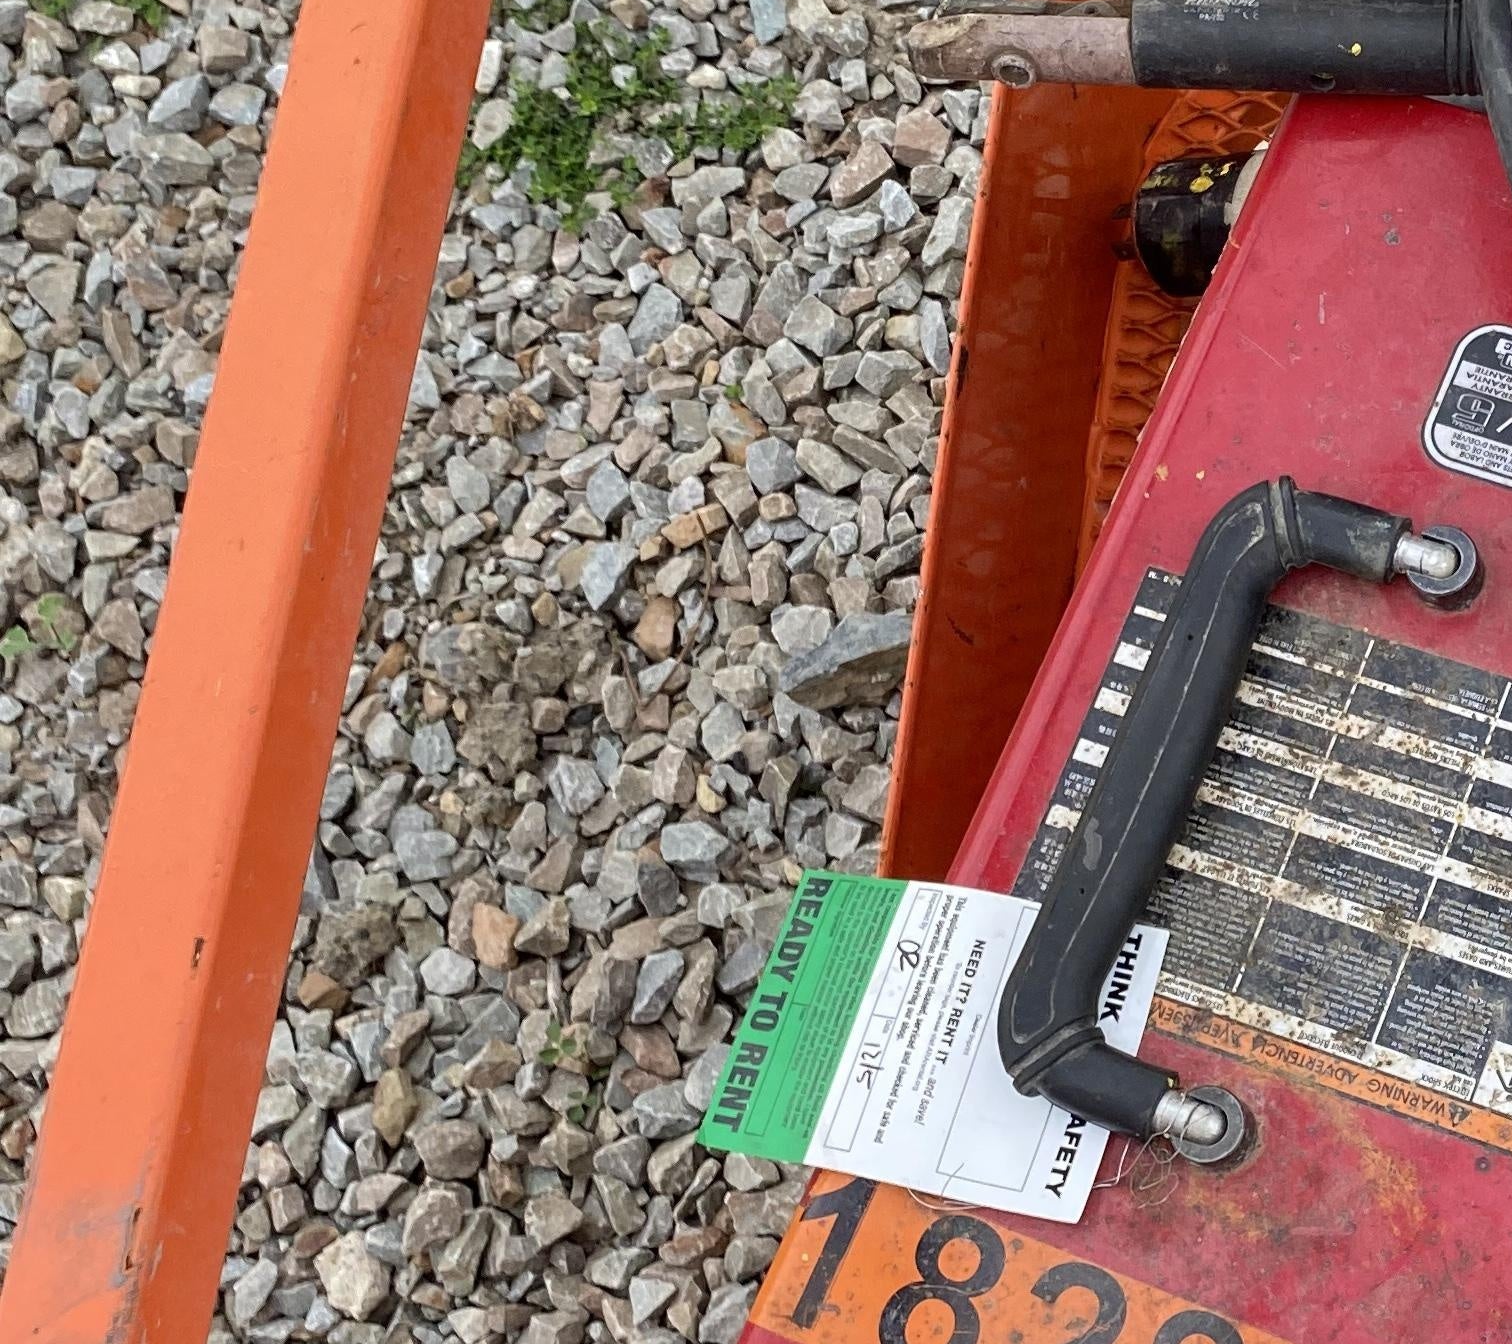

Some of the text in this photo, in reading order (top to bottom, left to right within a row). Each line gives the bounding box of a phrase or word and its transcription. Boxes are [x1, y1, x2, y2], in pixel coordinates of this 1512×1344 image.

[1450, 391, 1497, 428] 5
[1449, 440, 1470, 451] OBRA
[1458, 451, 1484, 463] LABOR
[1470, 446, 1482, 455] DE
[1482, 450, 1507, 462] MANO
[1487, 443, 1509, 455] MAIN
[1484, 458, 1501, 468] AND
[938, 893, 955, 918] proper
[926, 918, 946, 955] operation
[939, 911, 962, 952] equipment
[918, 953, 934, 979] before
[962, 937, 987, 979] NEED
[929, 965, 943, 986] been
[1100, 933, 1143, 1023] THINK
[954, 980, 972, 1004] IT?
[712, 877, 828, 1133] READY TO RENT
[939, 1006, 964, 1047] RENT
[900, 1049, 913, 1066] and
[933, 1048, 949, 1064] IT
[889, 1065, 908, 1098] checked
[922, 1077, 939, 1099] and
[1364, 1075, 1447, 1118] WARNING
[912, 1097, 933, 1126] save!
[1043, 1113, 1087, 1199] AFETY
